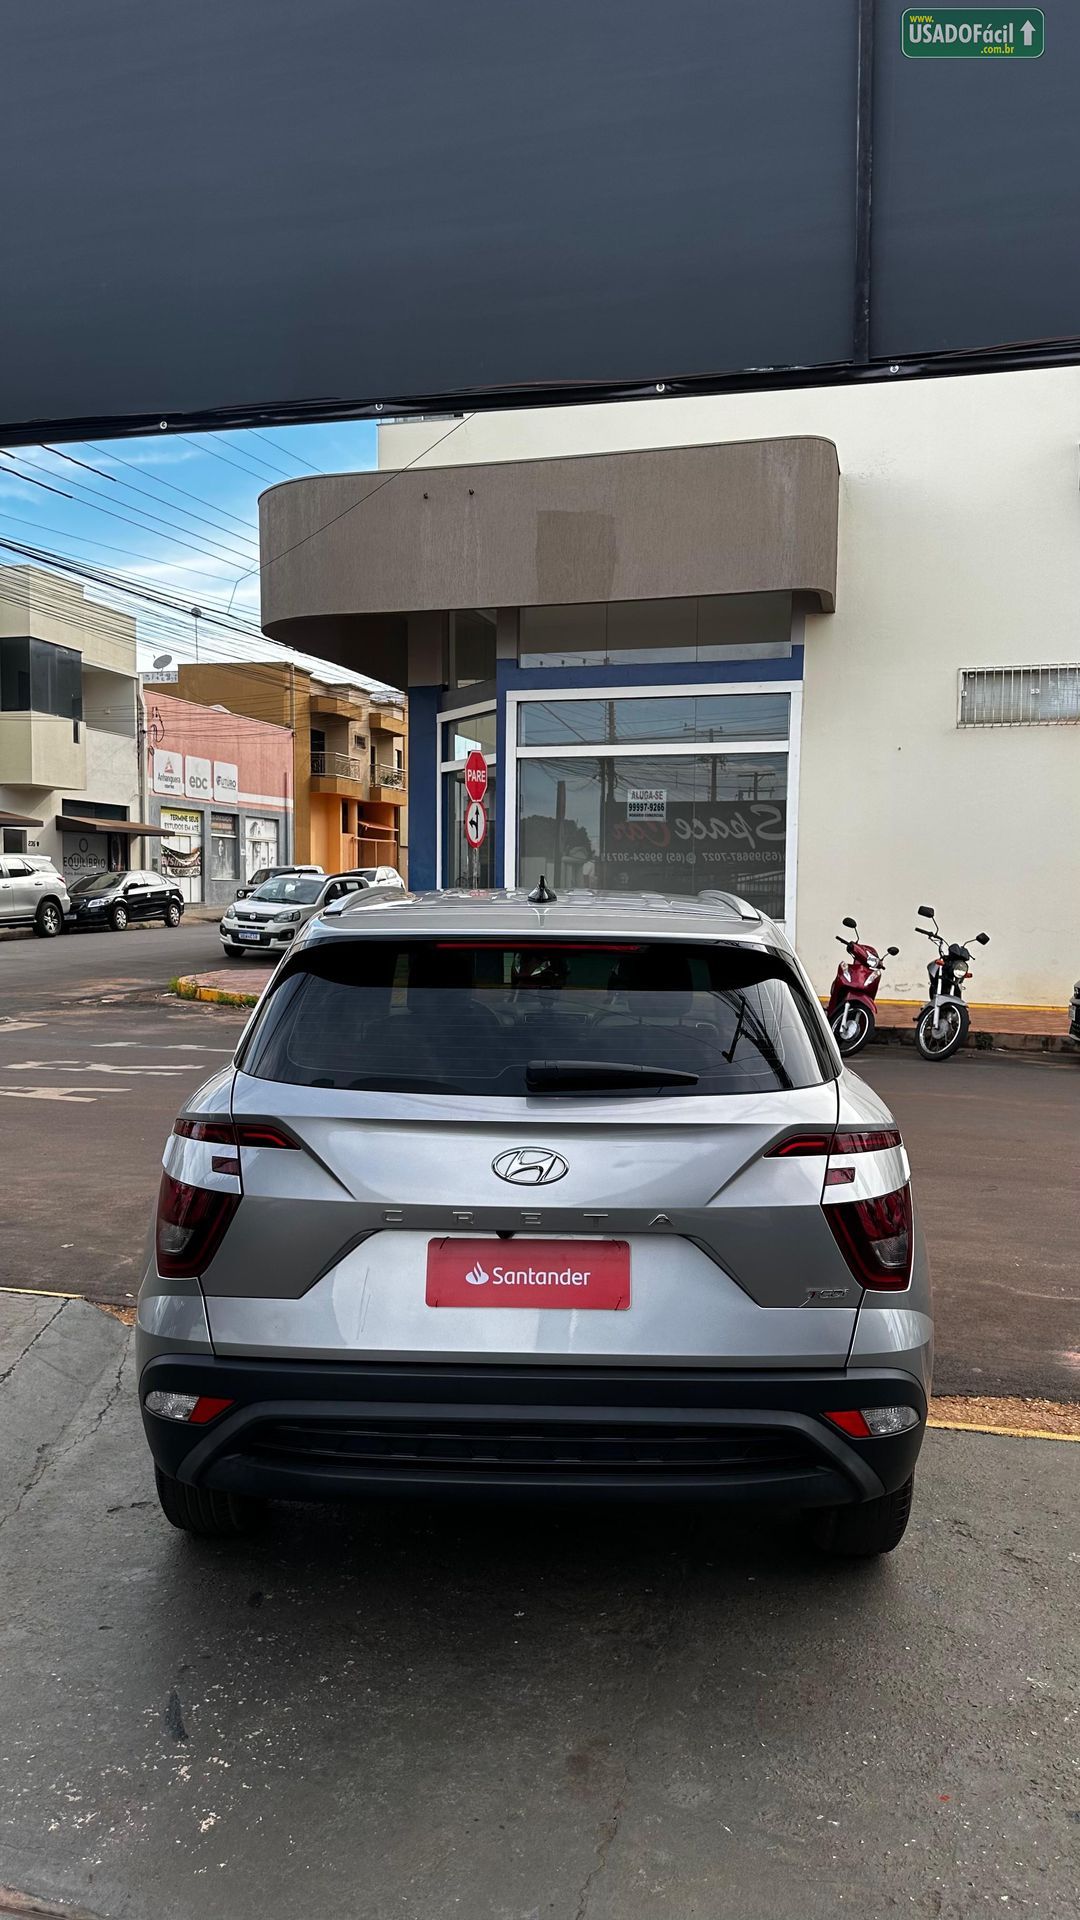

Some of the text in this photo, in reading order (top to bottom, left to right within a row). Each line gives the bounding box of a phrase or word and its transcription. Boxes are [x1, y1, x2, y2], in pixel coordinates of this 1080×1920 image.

[467, 769, 486, 782] PARE
[631, 790, 664, 800] ALUGA-SE
[384, 1209, 673, 1226] CRETA
[492, 1267, 591, 1286] Santander
